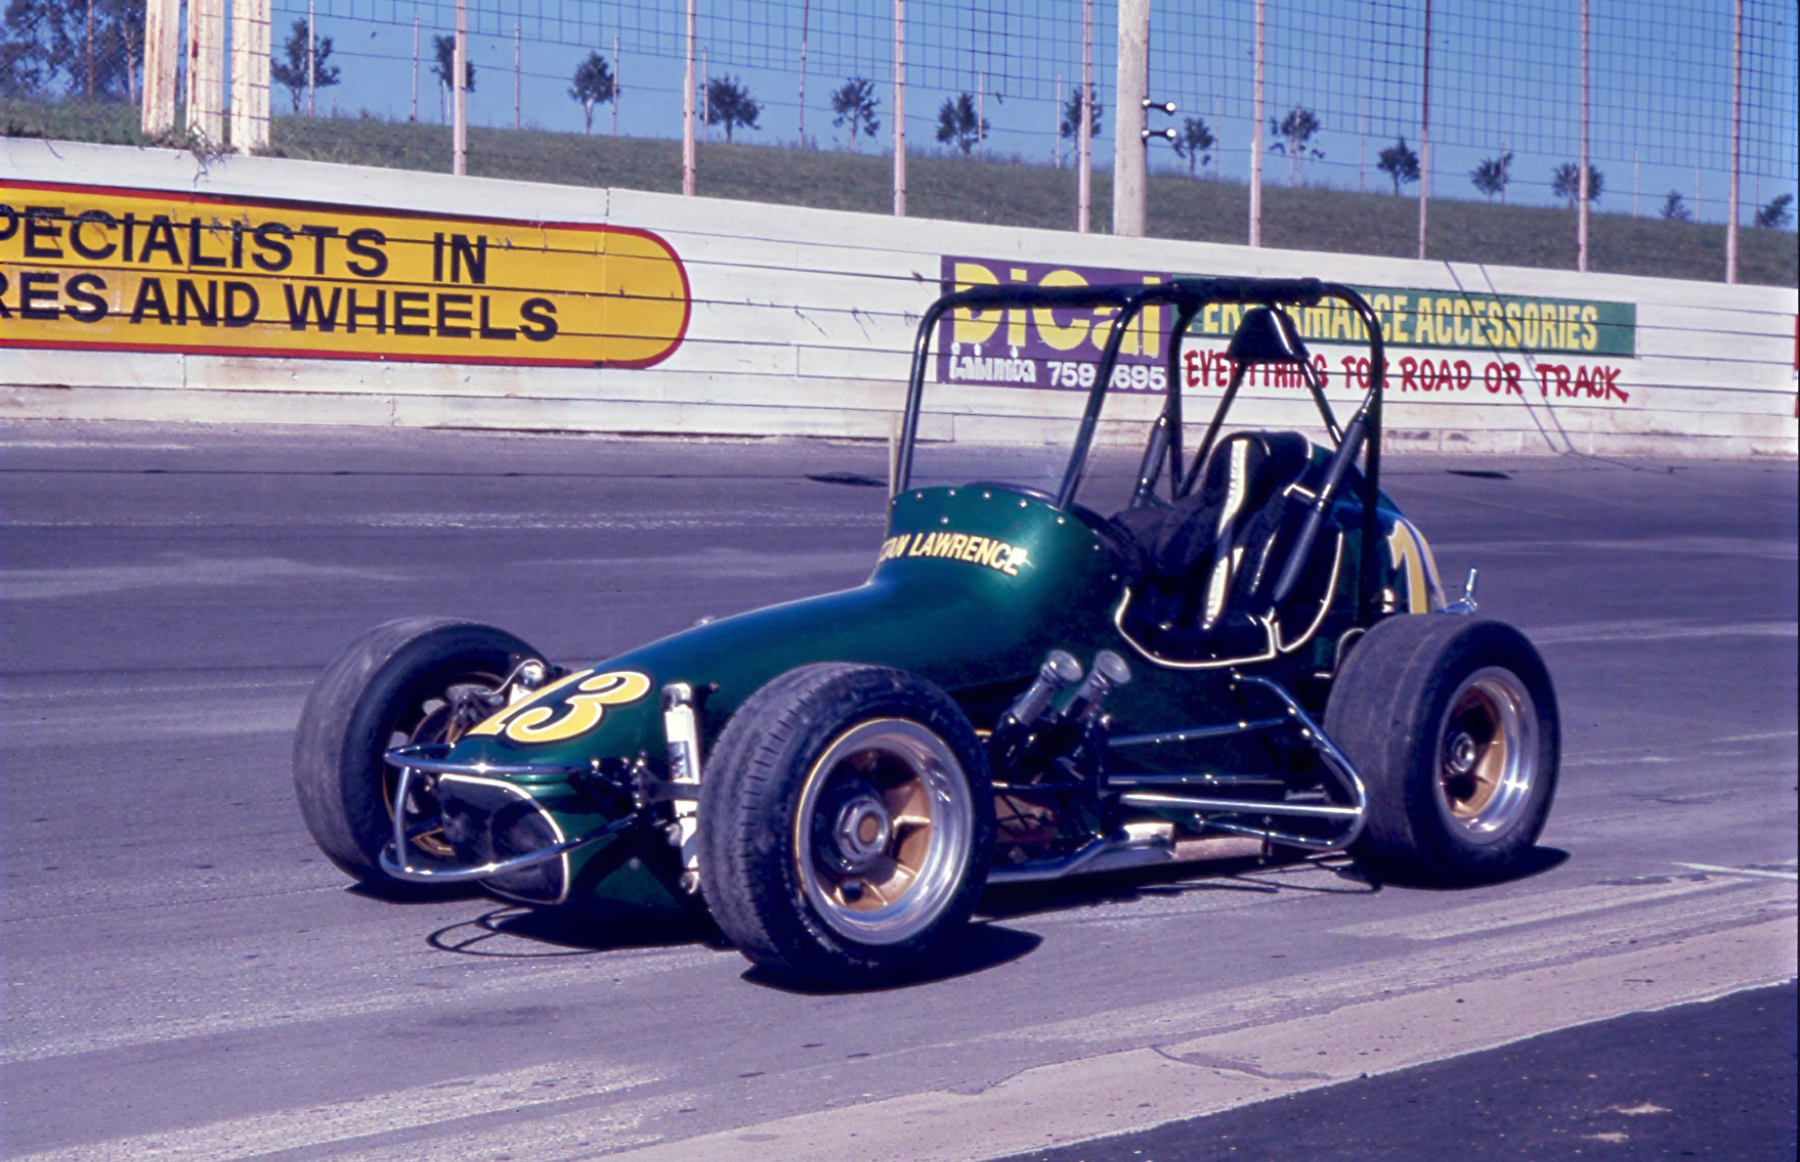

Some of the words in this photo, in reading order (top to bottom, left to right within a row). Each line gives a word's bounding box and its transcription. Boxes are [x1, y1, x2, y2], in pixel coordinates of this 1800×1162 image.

[433, 232, 487, 285] IN
[129, 277, 261, 328] AND
[282, 284, 559, 342] WHEELS
[1414, 296, 1598, 351] ACCESSORIES
[1399, 356, 1472, 392] ROAD
[1484, 361, 1524, 395] OR
[1535, 363, 1630, 404] TRACK
[907, 532, 1028, 576] LAWRENCE
[466, 669, 651, 742] 13
